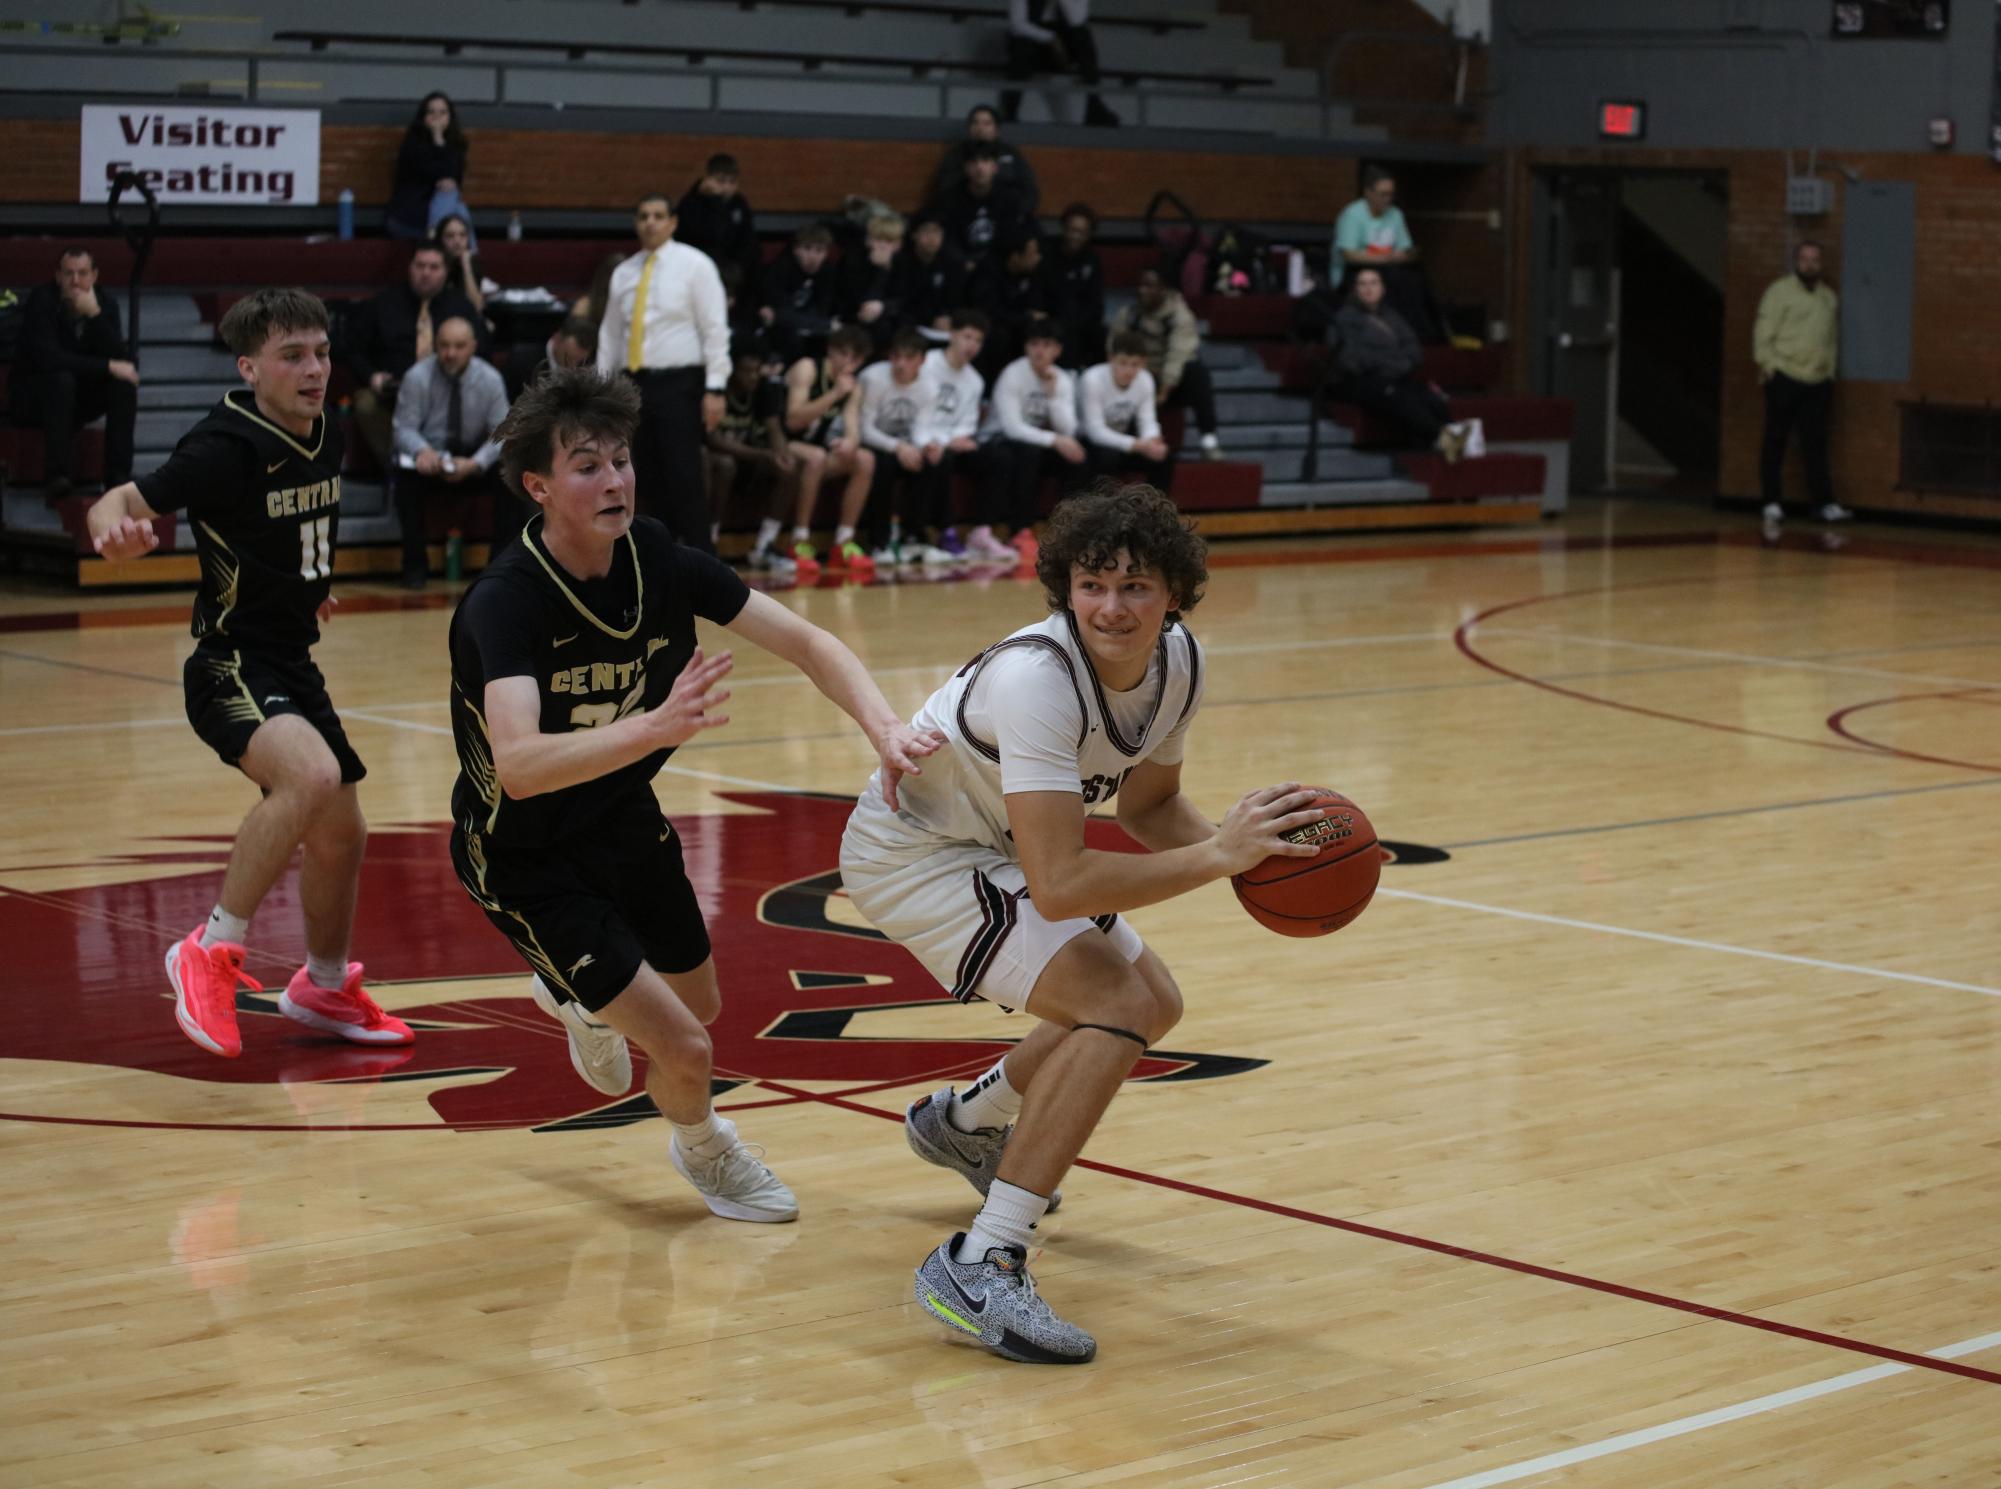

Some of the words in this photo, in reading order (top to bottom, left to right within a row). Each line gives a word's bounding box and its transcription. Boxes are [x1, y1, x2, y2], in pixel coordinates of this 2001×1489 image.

[118, 114, 286, 148] Visitor
[299, 515, 331, 582] 11
[1285, 815, 1353, 845] EGACY
